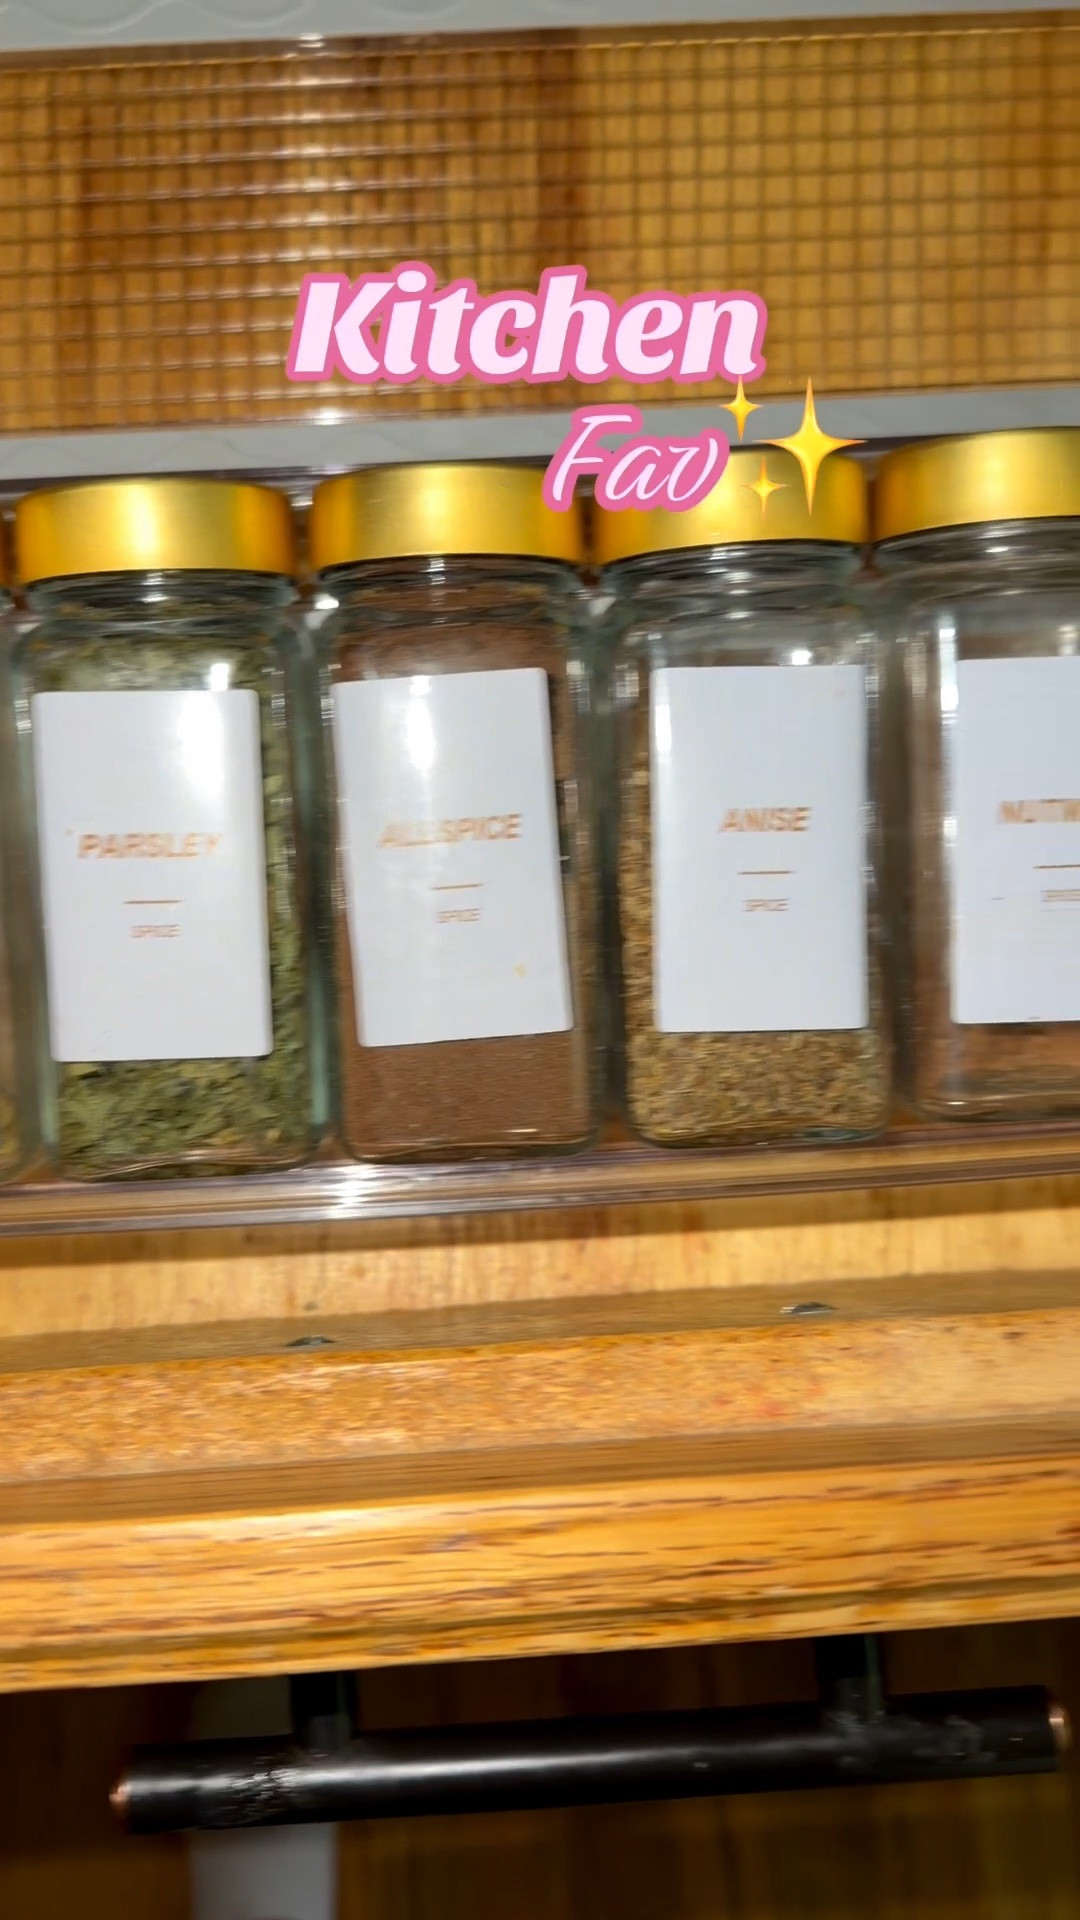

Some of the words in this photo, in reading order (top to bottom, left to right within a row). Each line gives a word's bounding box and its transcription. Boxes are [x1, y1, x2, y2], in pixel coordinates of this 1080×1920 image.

[377, 813, 522, 849] ALLSPICE
[718, 806, 812, 832] ANISE
[77, 833, 222, 859] PARSLEY
